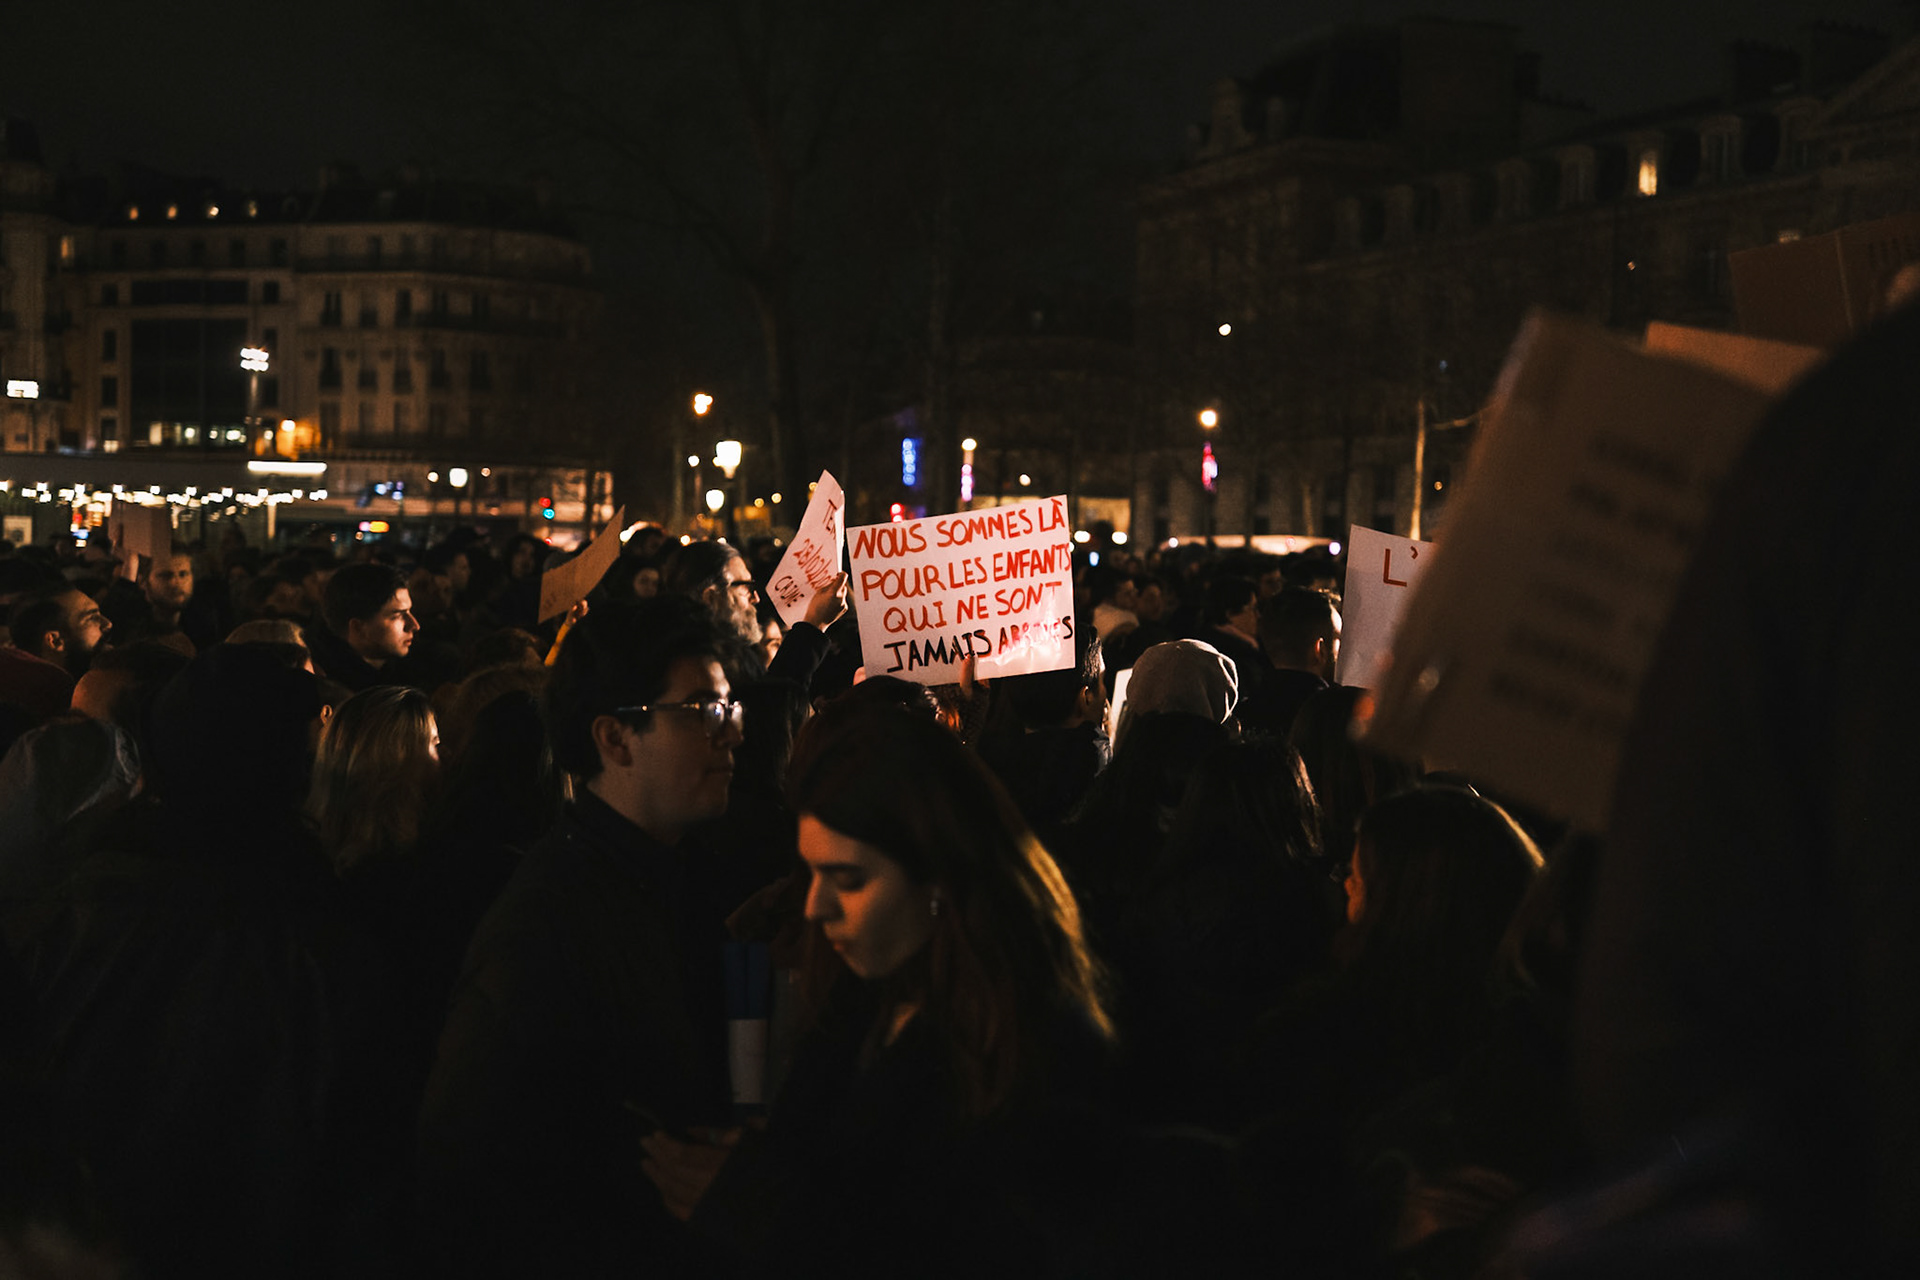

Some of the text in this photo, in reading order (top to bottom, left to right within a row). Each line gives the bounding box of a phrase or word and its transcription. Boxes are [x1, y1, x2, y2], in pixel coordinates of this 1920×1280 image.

[853, 498, 1065, 559] NOUS SOMMES LÀ
[860, 542, 1073, 601] POUR LES ENFANTS
[883, 581, 1062, 633] QUI NE SONT
[883, 629, 992, 673] JAMAIS
